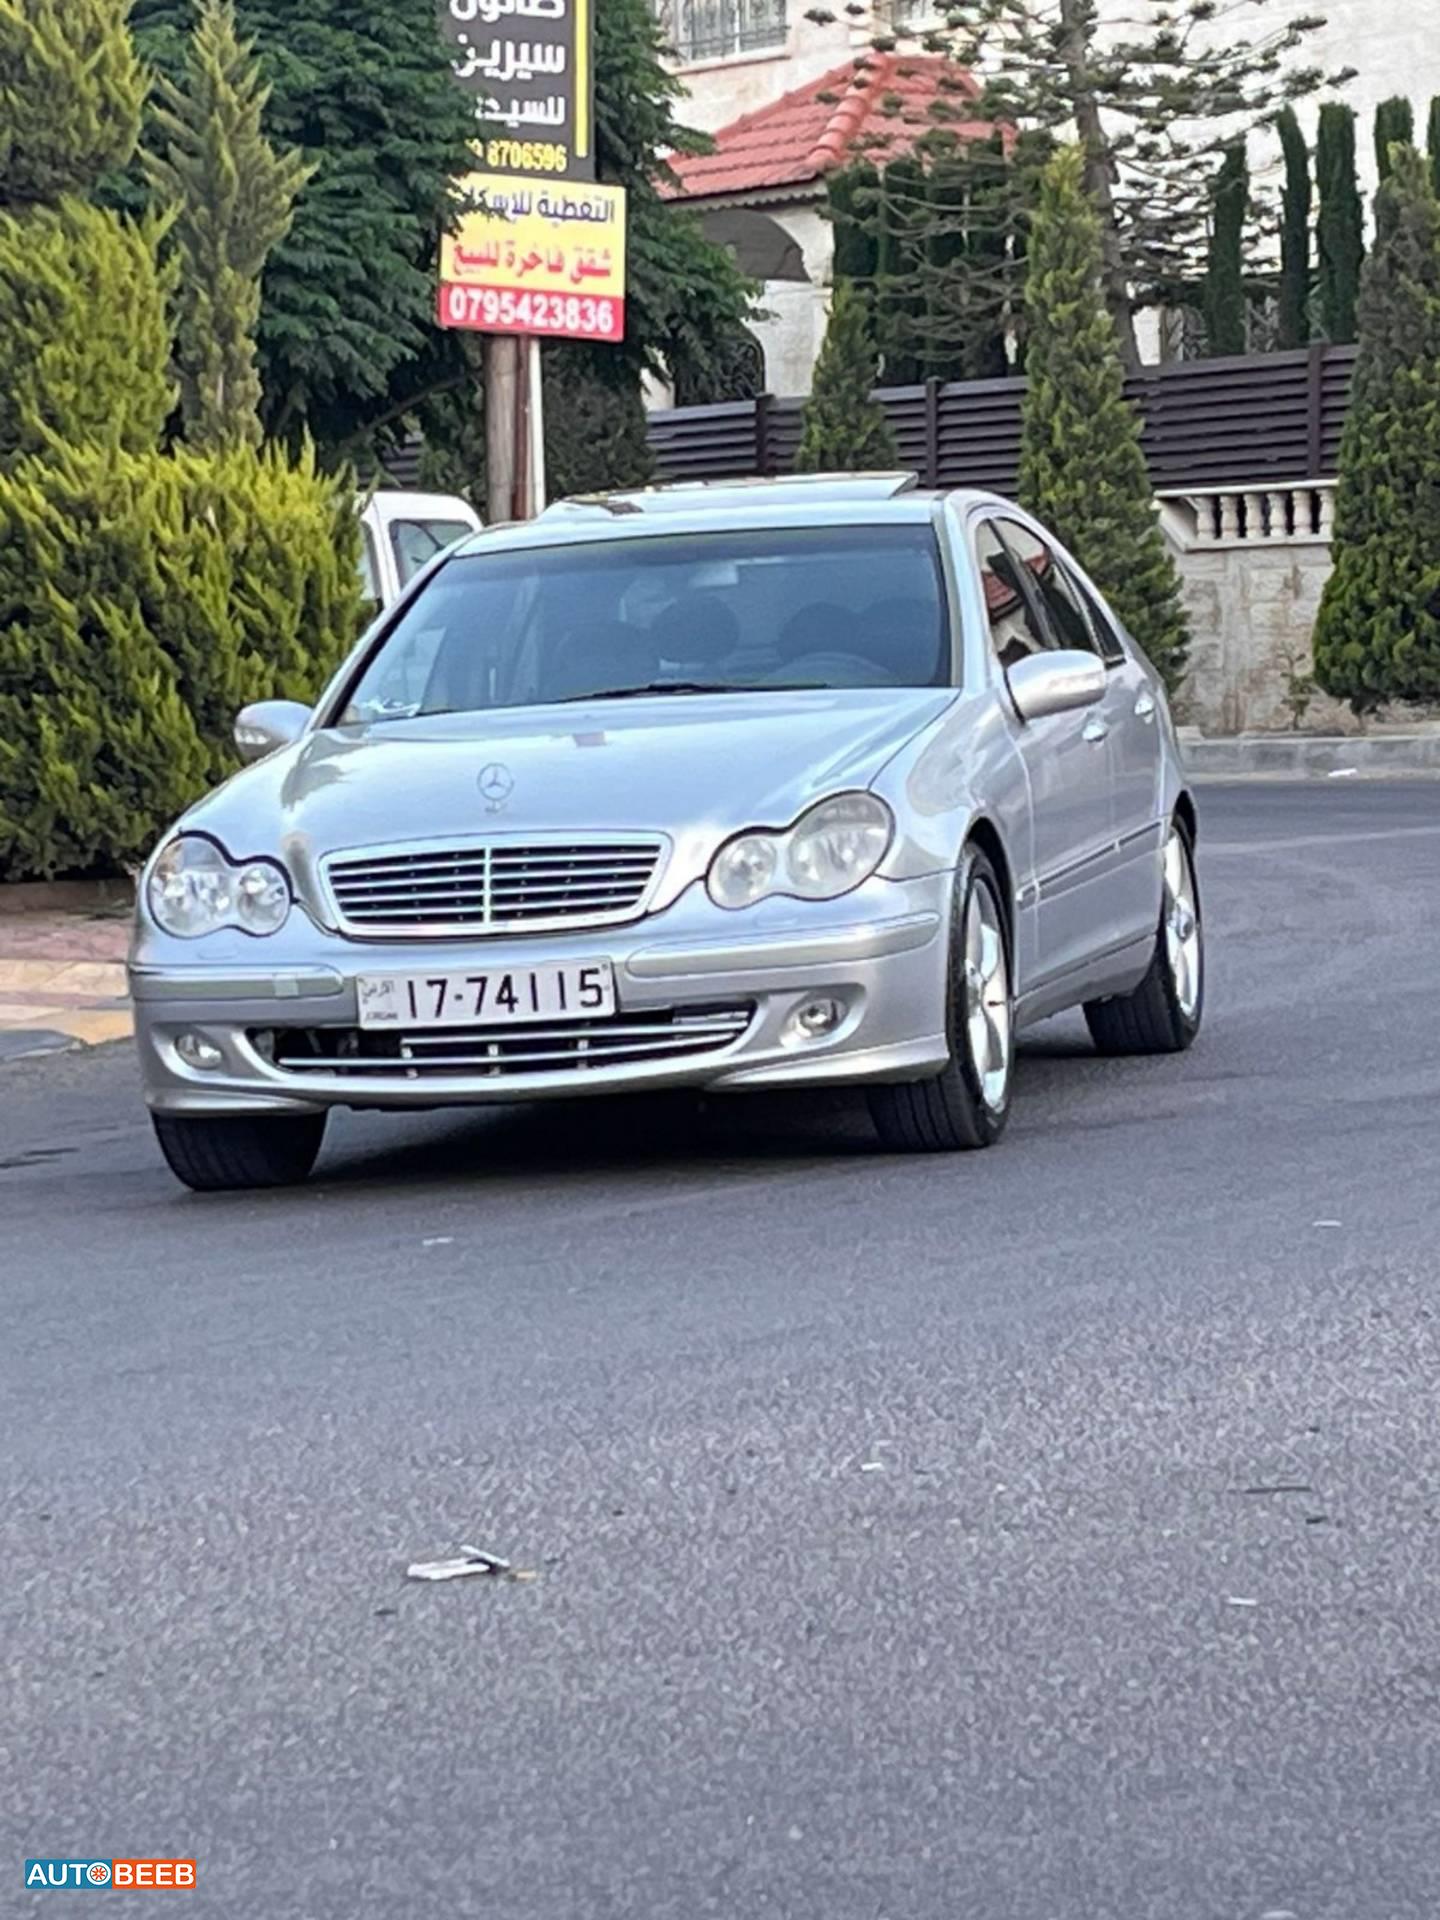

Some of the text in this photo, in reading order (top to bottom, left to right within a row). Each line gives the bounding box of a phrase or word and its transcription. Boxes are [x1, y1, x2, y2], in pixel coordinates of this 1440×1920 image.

[450, 33, 566, 81] سيريز
[452, 239, 612, 285] شقق فاخرة للبيع
[449, 286, 614, 334] 0795423836
